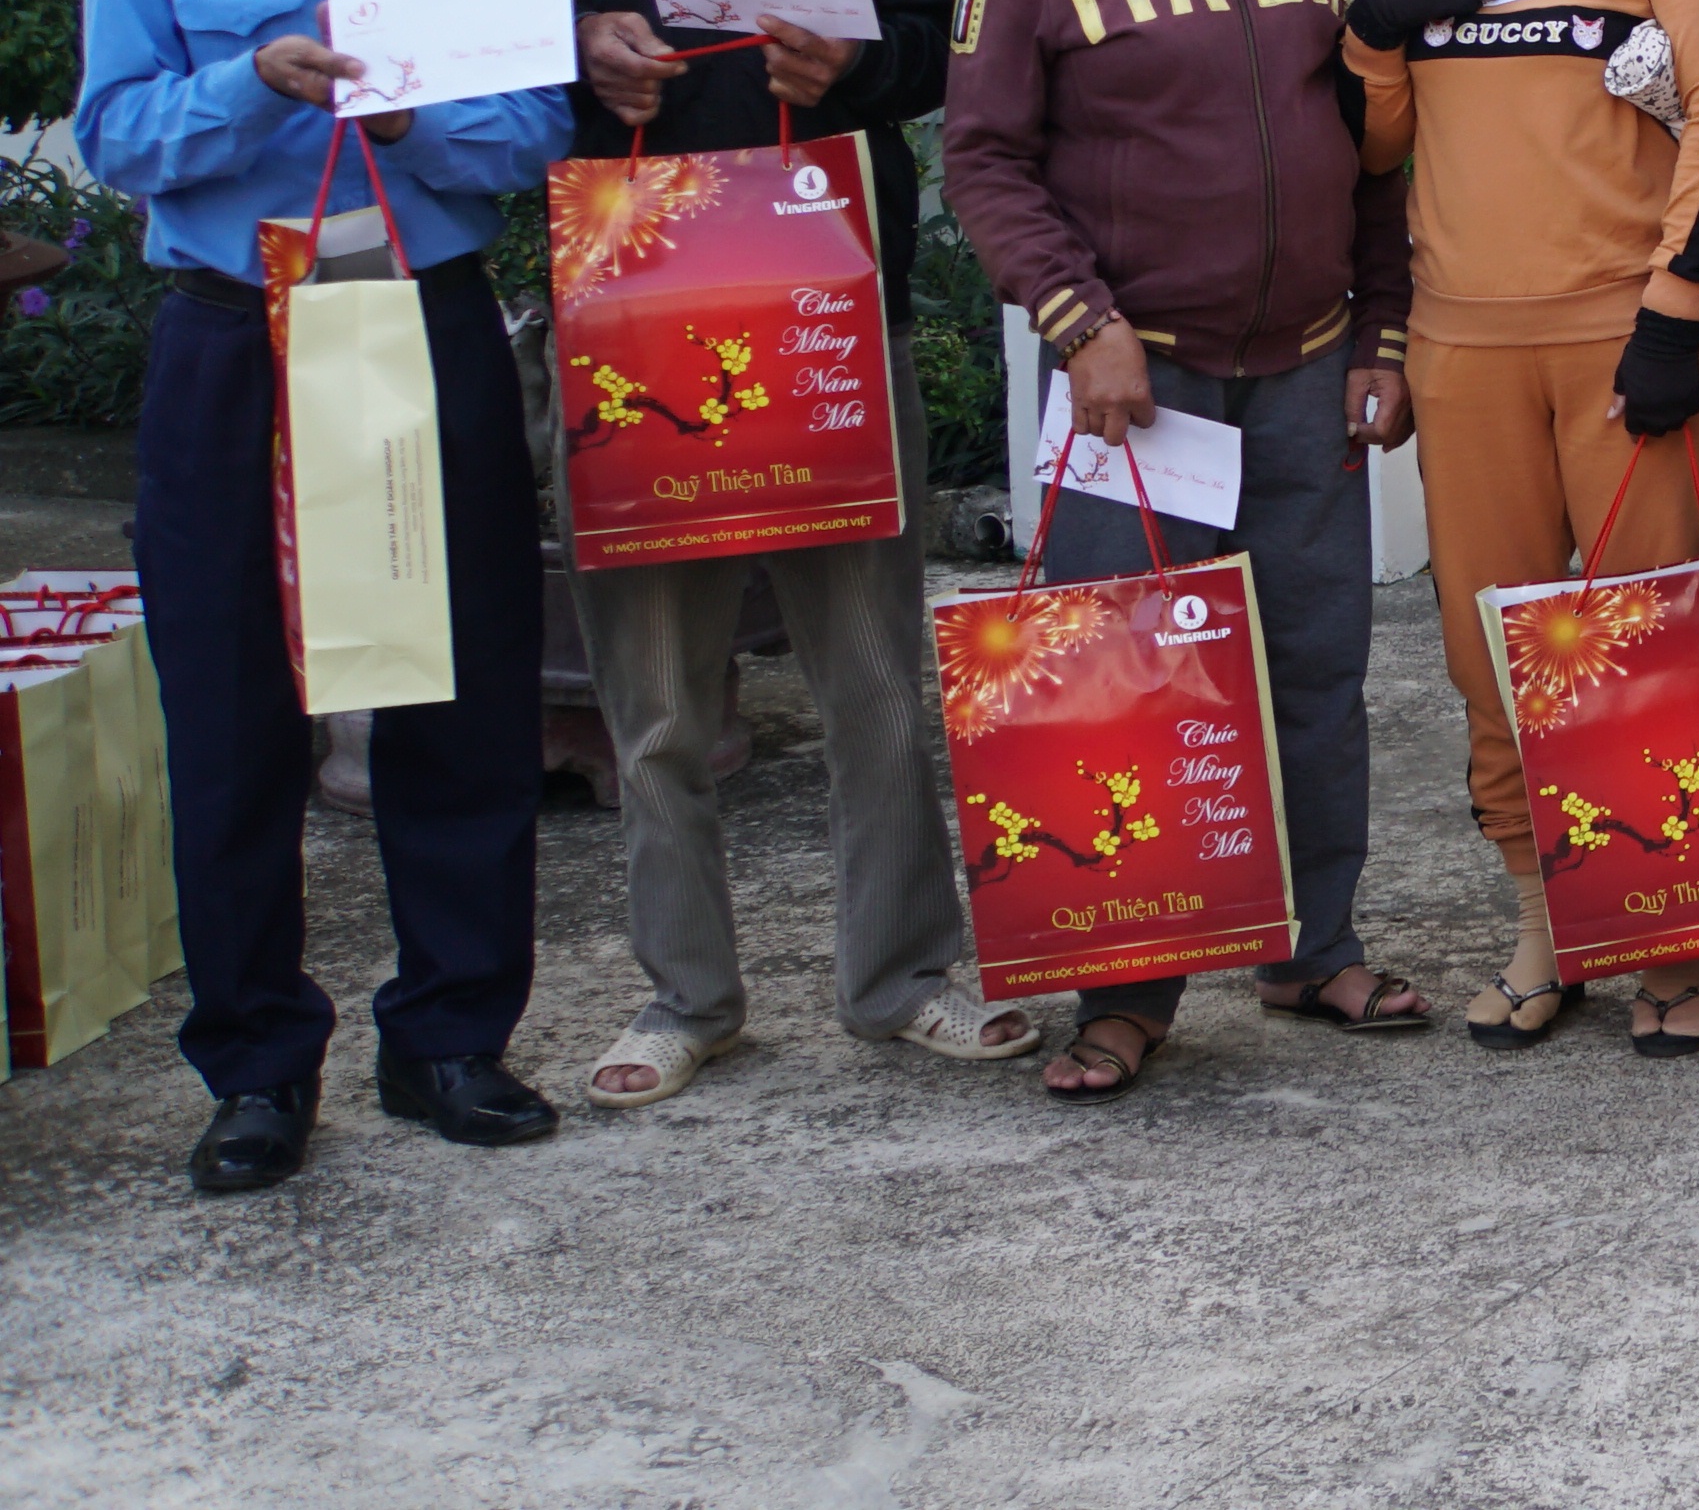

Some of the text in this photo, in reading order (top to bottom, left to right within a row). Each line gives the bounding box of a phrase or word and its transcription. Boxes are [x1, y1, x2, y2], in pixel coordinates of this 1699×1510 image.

[1455, 20, 1569, 45] GUCCY
[774, 197, 850, 215] VINGROUP
[791, 288, 854, 317] Chúc
[779, 324, 858, 360] Mừng
[793, 366, 861, 396] Năm
[809, 400, 865, 432] Mới
[654, 464, 811, 502] Quỹ Thiện Tâm
[602, 543, 613, 554] VÌ
[615, 540, 642, 553] MỘT
[642, 536, 676, 550] CUỘC
[676, 532, 710, 546] SỐNG
[710, 529, 733, 542] TỐT
[755, 525, 783, 537] HƠN
[783, 522, 810, 534] CHO
[810, 517, 848, 531] NGƯỜI
[848, 514, 872, 527] VIỆT
[1155, 627, 1231, 647] VINGROUP
[1176, 720, 1239, 747] Chúc
[1167, 754, 1243, 789] Mừng
[1181, 794, 1248, 826] Năm
[1199, 827, 1253, 861] Mới
[1051, 891, 1203, 932] Quỹ Thiện Tâm
[1624, 889, 1668, 916] Quỹ
[1005, 973, 1016, 985] VÌ
[1017, 970, 1043, 983] MỘT
[1043, 966, 1075, 979] CUỘC
[1076, 961, 1108, 975] SỐNG
[1108, 956, 1130, 970] TỐT
[1152, 951, 1178, 964] HƠN
[1178, 948, 1204, 960] CHO
[1204, 942, 1241, 956] NGƯỜI
[1241, 938, 1263, 952] VIỆT
